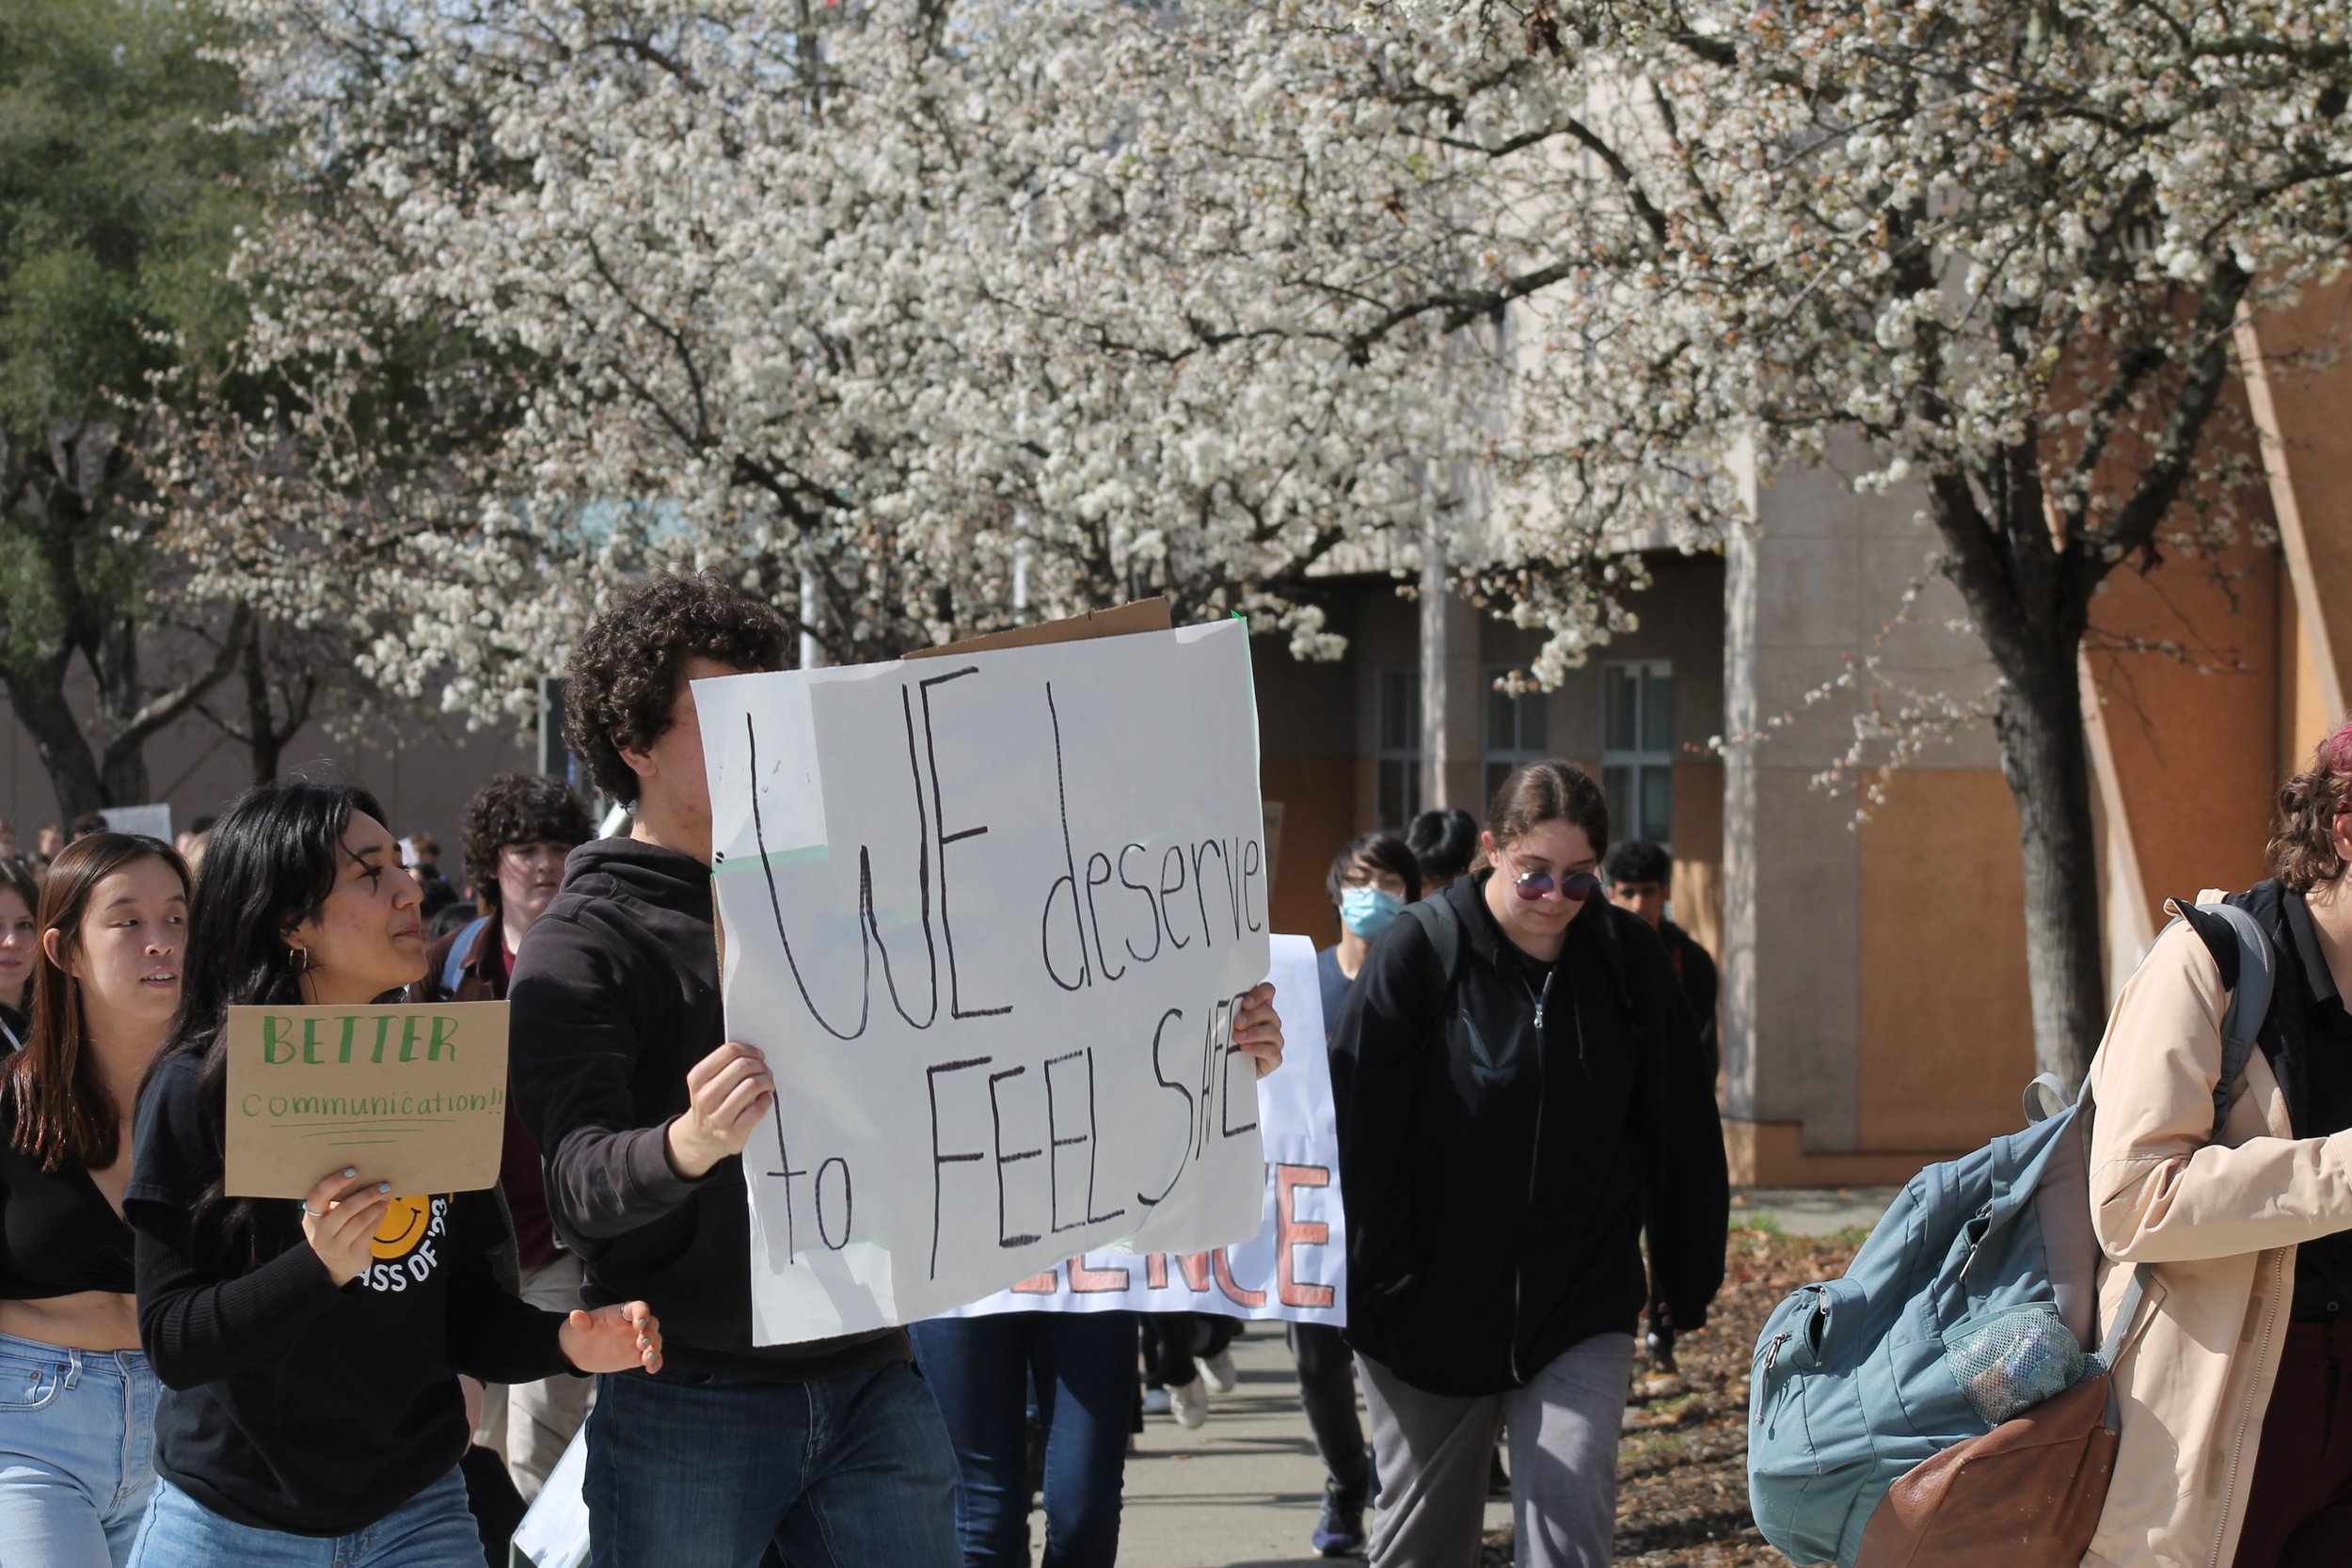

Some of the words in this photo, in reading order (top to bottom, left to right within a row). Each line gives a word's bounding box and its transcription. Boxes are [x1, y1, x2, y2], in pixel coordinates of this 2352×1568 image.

[747, 666, 1013, 1039] WE
[1042, 682, 1261, 990] deserve
[263, 1015, 458, 1065] BETTER
[767, 1088, 852, 1265] to
[928, 1047, 1125, 1280] FEEL
[1137, 991, 1257, 1206] SAFE
[407, 1239, 437, 1282] OF
